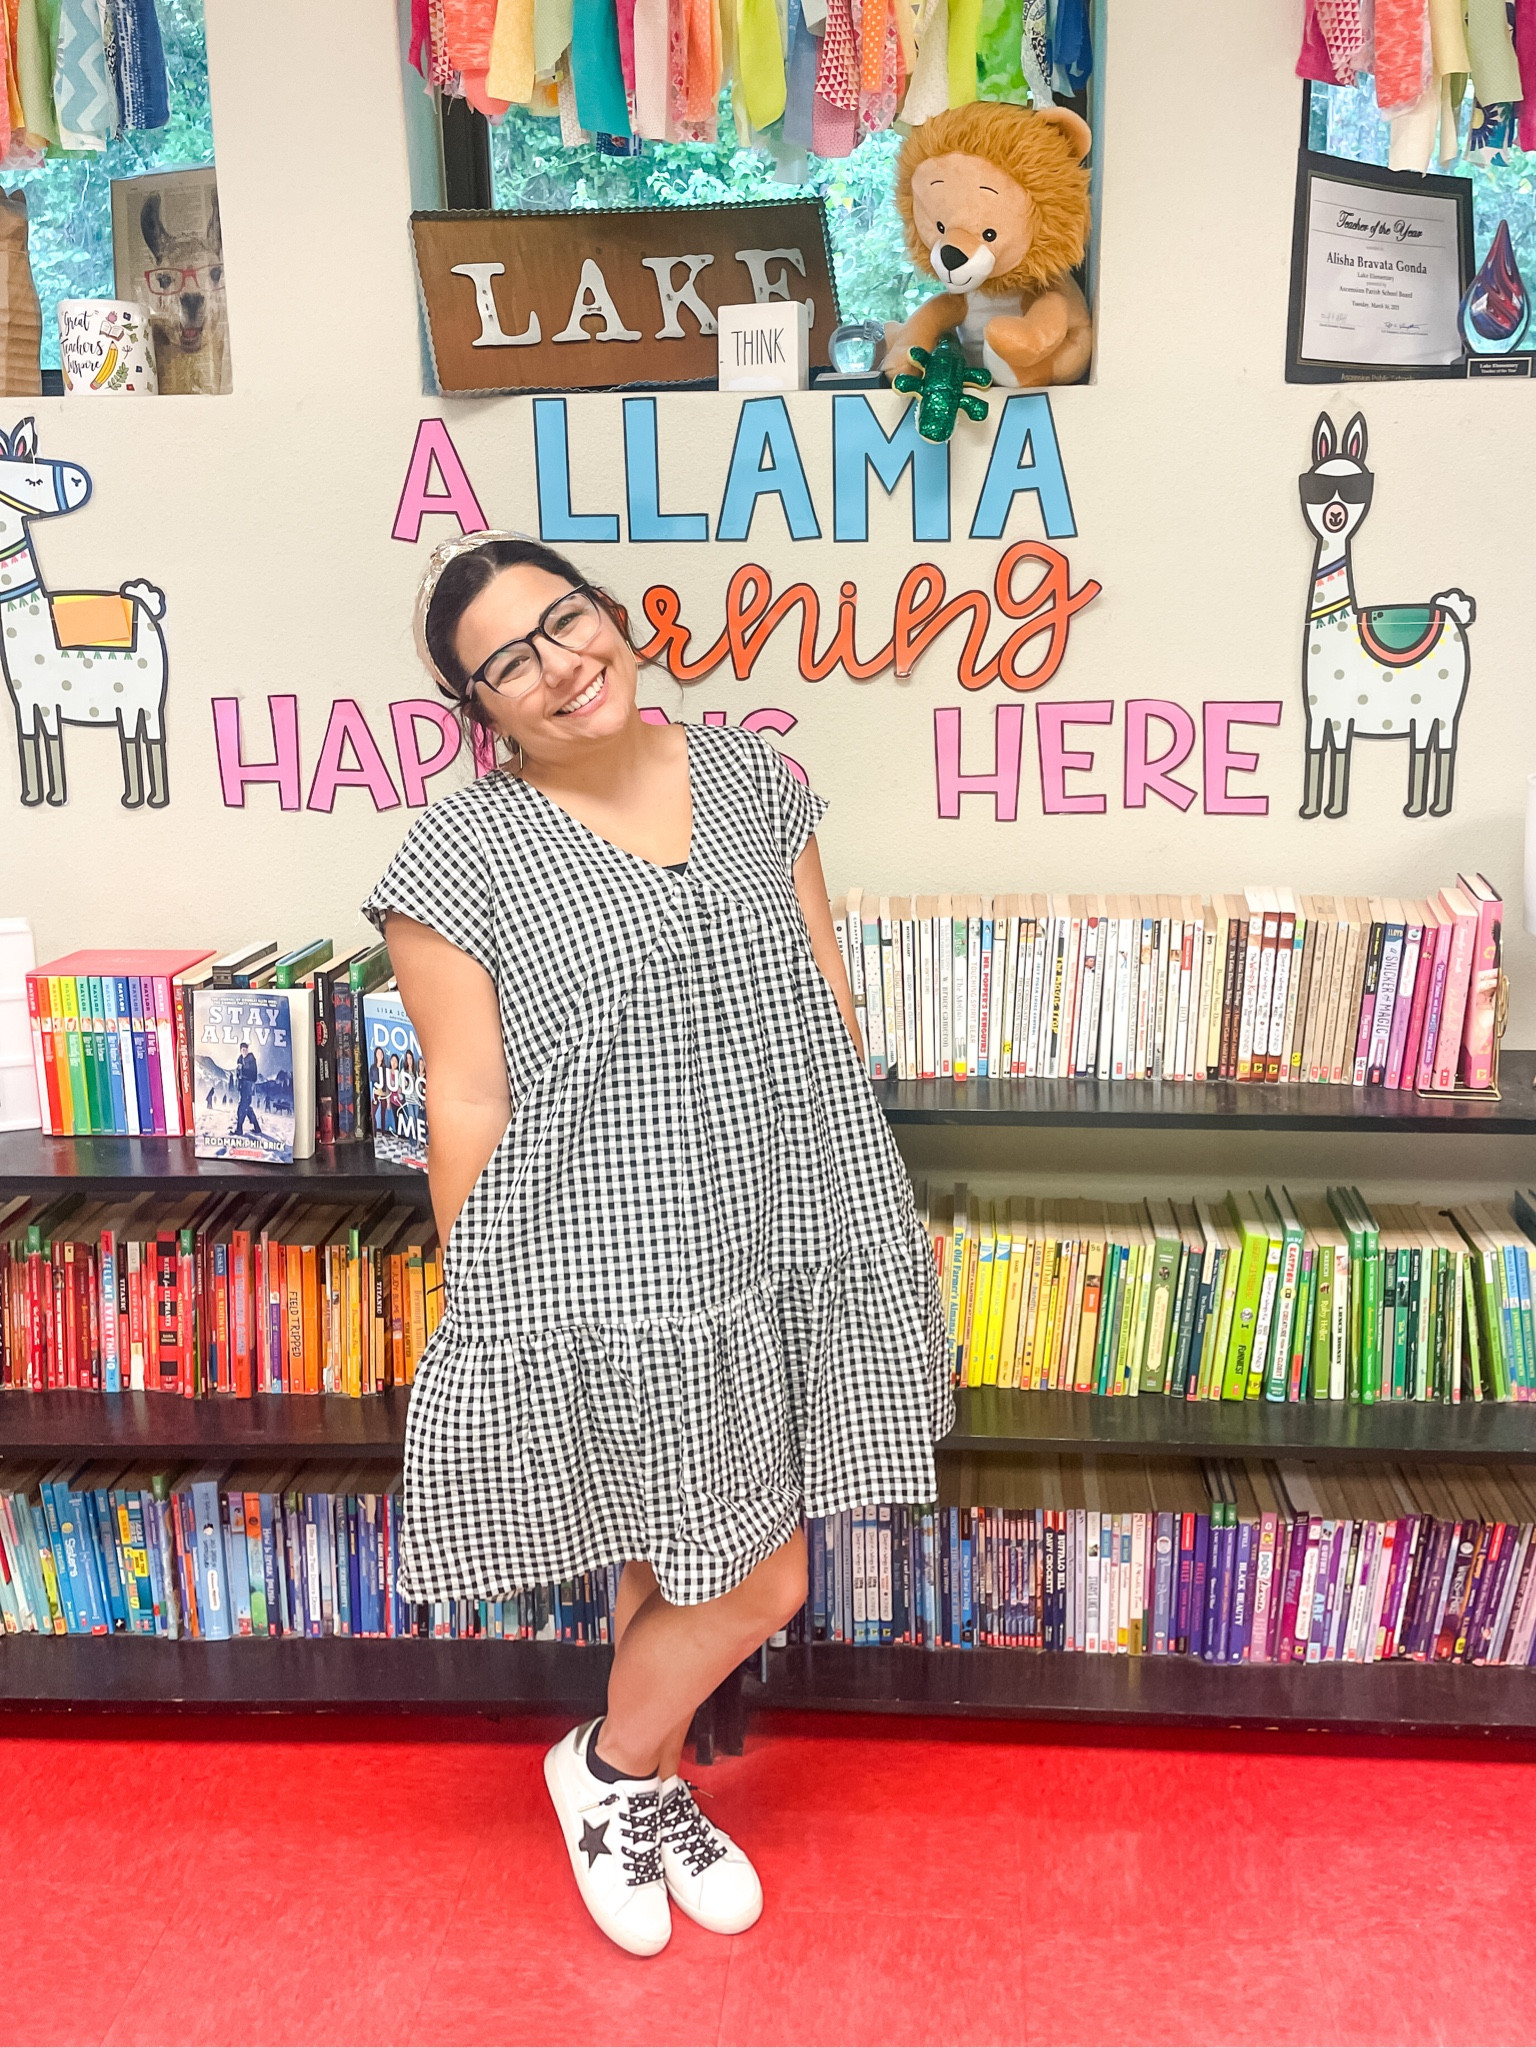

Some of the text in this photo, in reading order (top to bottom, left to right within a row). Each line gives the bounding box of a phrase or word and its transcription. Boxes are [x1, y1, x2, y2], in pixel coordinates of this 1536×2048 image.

[1337, 210, 1423, 241] Teacher of the Year
[1327, 252, 1427, 275] Alisha Bravata Gonda
[64, 311, 92, 336] Great
[60, 336, 103, 356] Teachers
[731, 327, 786, 367] THINK
[67, 356, 101, 378] Inspire
[391, 392, 1078, 543] A LLAMA
[594, 540, 1102, 692] rning
[933, 700, 1284, 822] HERE
[1056, 956, 1064, 971] The
[1247, 961, 1256, 983] Wimpy
[1384, 956, 1398, 992] SNICKER
[970, 962, 978, 998] TOUCHING
[1053, 975, 1063, 1006] Magic
[1248, 985, 1256, 996] Kid
[28, 983, 36, 1011] NAYLOR
[208, 1006, 280, 1027] STAY
[969, 1000, 977, 1022] SPIRIT
[1378, 1004, 1392, 1034] MAGIC
[201, 1025, 288, 1048] ALIVE
[373, 1022, 422, 1057] DON
[373, 1066, 427, 1101] JUDG
[204, 1137, 286, 1152] RODMAN PHILBRICK
[954, 1232, 963, 1246] The
[163, 1257, 171, 1278] WATER
[216, 1247, 224, 1274] RASKIN
[235, 1256, 244, 1274] THE
[953, 1249, 963, 1262] Old
[951, 1265, 962, 1299] Farmer's
[164, 1290, 172, 1327] ELEPHANTS
[1029, 1286, 1038, 1313] handful
[1320, 1300, 1330, 1318] Ruby
[103, 1257, 115, 1370] TELL ME EVERYTHING
[289, 1291, 302, 1358] FIELD TRIPPED
[948, 1301, 957, 1335] Almanac
[236, 1326, 246, 1356] GAME
[1319, 1320, 1328, 1342] Holler
[1235, 1345, 1247, 1375] FUNNIEST
[47, 1504, 58, 1532] SPINELLI
[1045, 1533, 1053, 1553] DAVY
[65, 1538, 78, 1577] Sisters
[1057, 1535, 1065, 1590] BUFFALO BILL
[1260, 1554, 1270, 1577] DORK
[1522, 1567, 1530, 1575] A
[964, 1570, 970, 1578] To
[1088, 1576, 1098, 1596] STRAYS
[1237, 1562, 1247, 1590] BLACK
[1285, 1569, 1301, 1605] Braced
[1313, 1545, 1328, 1623] QUINN ARF
[1518, 1576, 1528, 1595] BOY
[1088, 1597, 1098, 1609] LIKE
[1235, 1593, 1245, 1626] BEAUTY
[1515, 1596, 1523, 1608] AT
